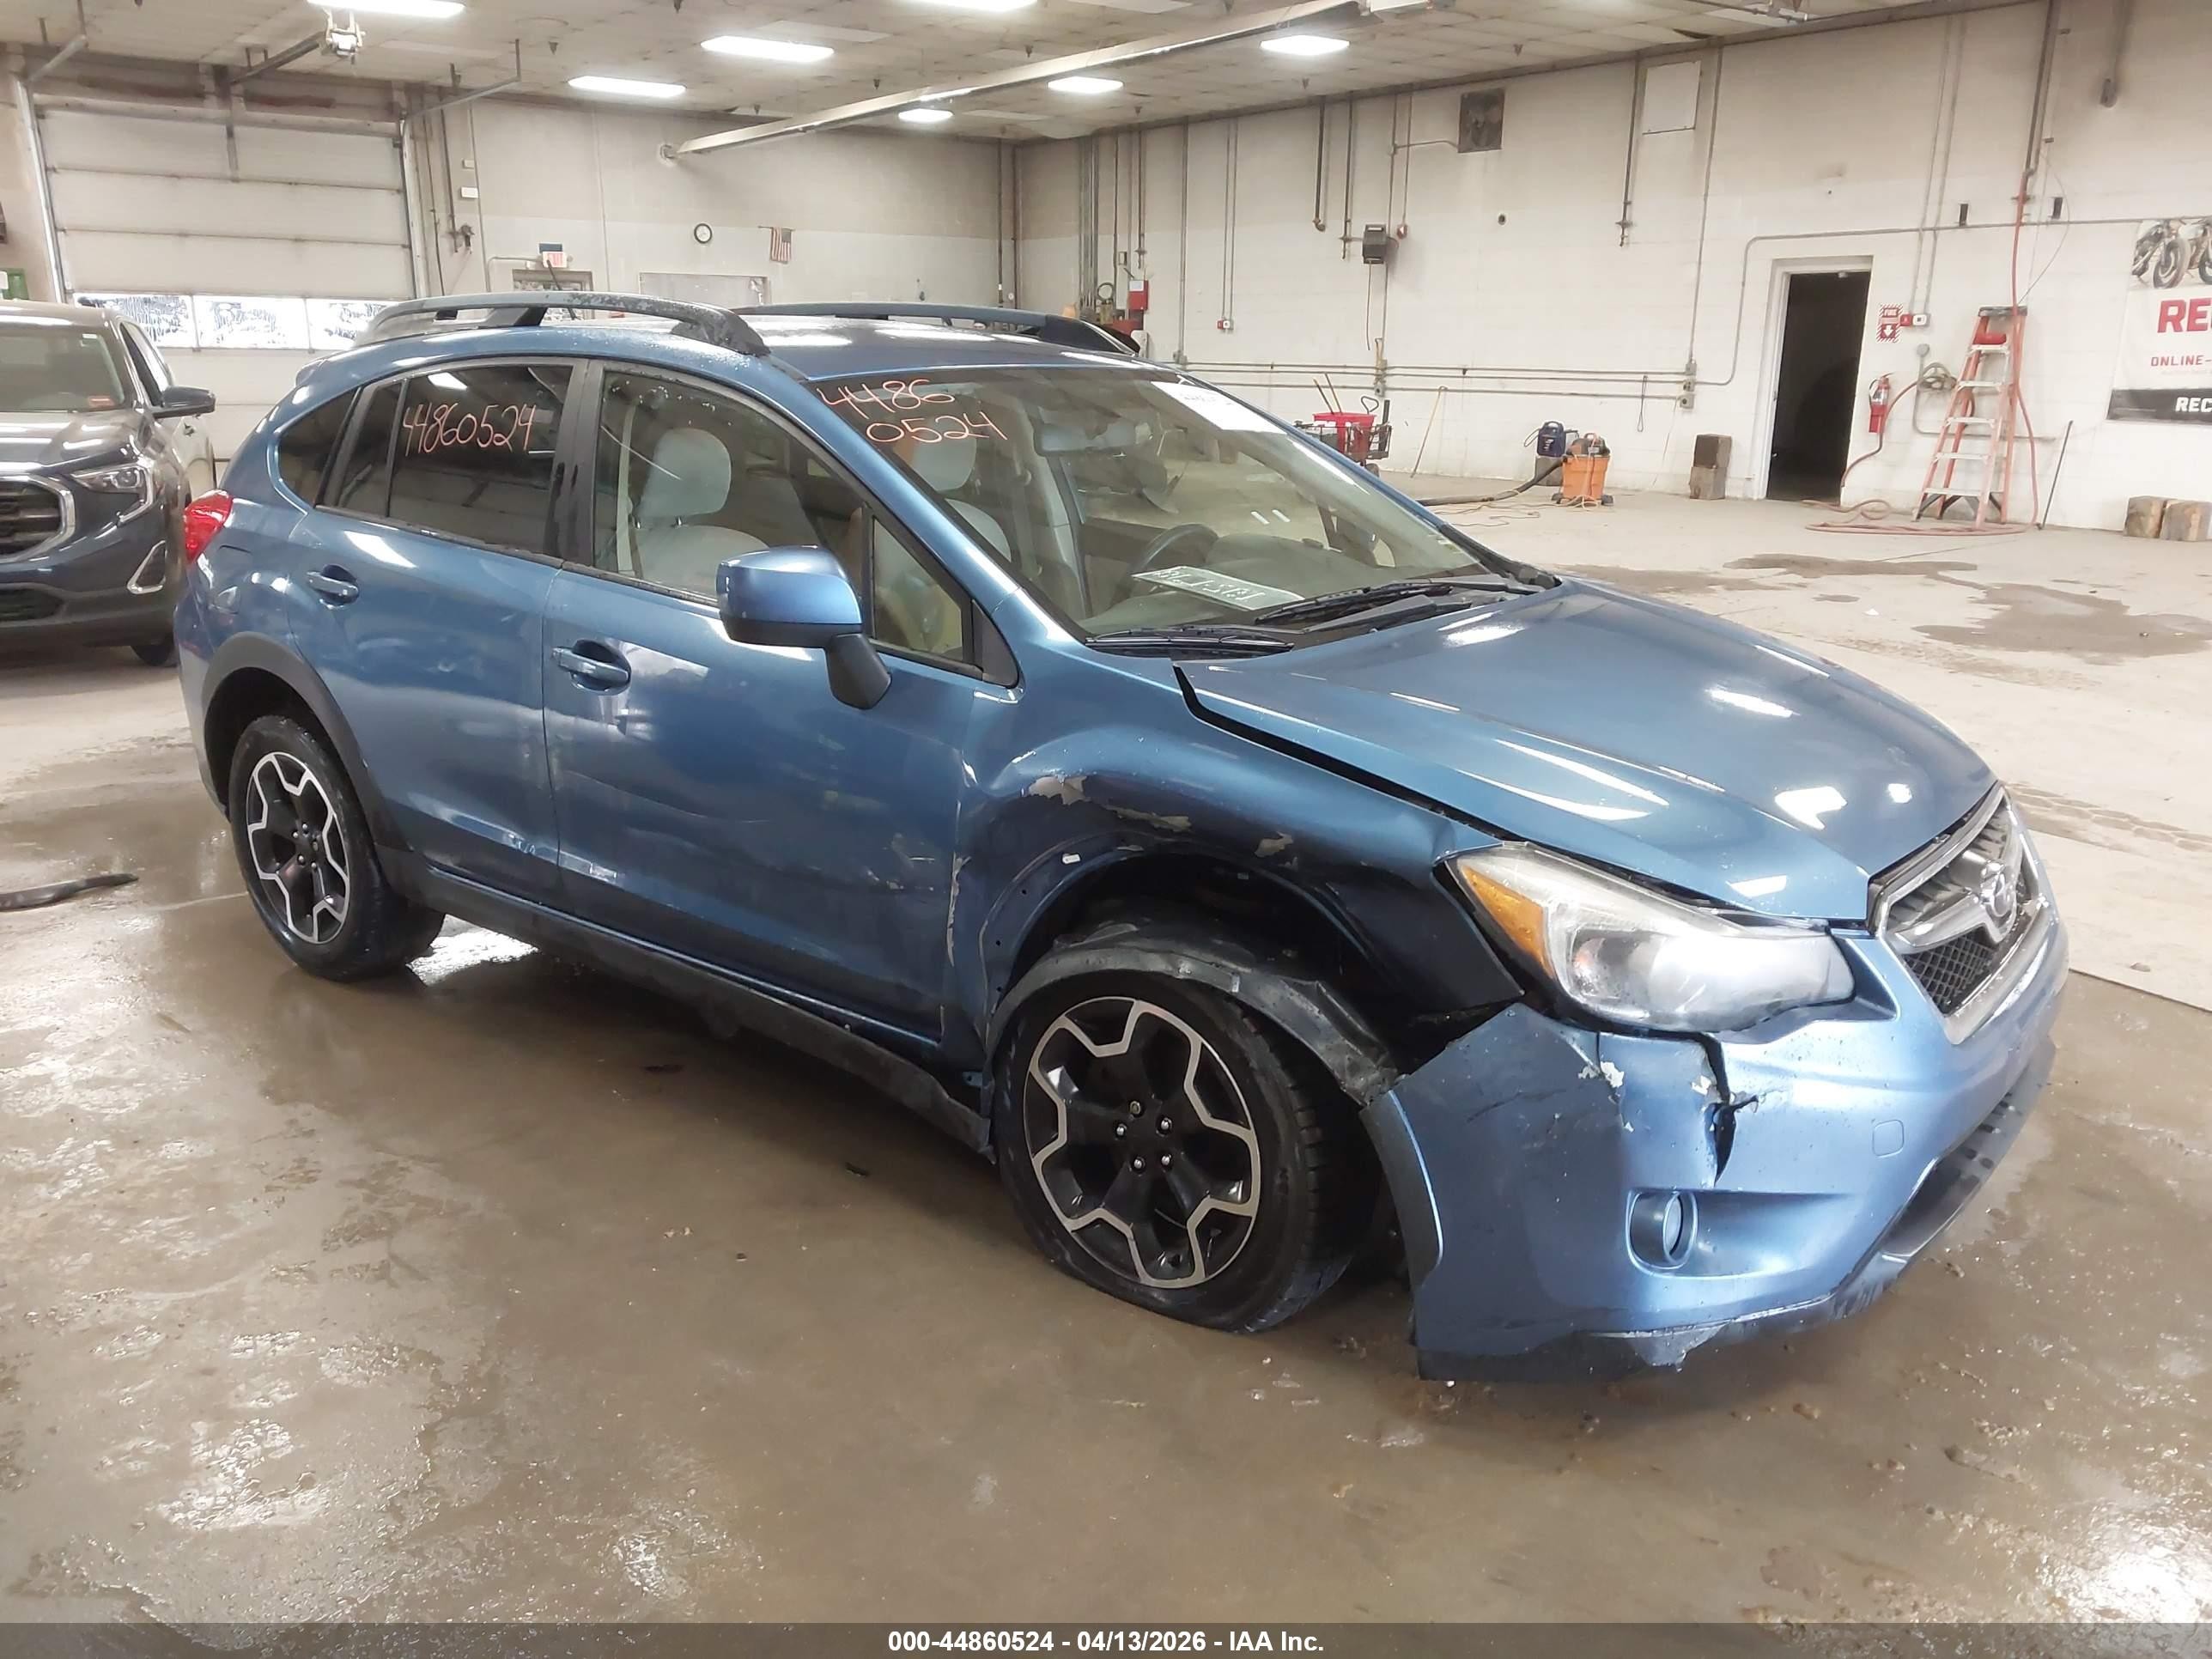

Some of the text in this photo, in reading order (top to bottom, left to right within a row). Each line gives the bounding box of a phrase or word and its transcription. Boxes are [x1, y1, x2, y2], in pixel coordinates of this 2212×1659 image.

[2157, 297, 2212, 333] RE
[817, 379, 955, 420] 4486
[403, 402, 537, 457] 44860524
[866, 410, 1008, 443] 0524
